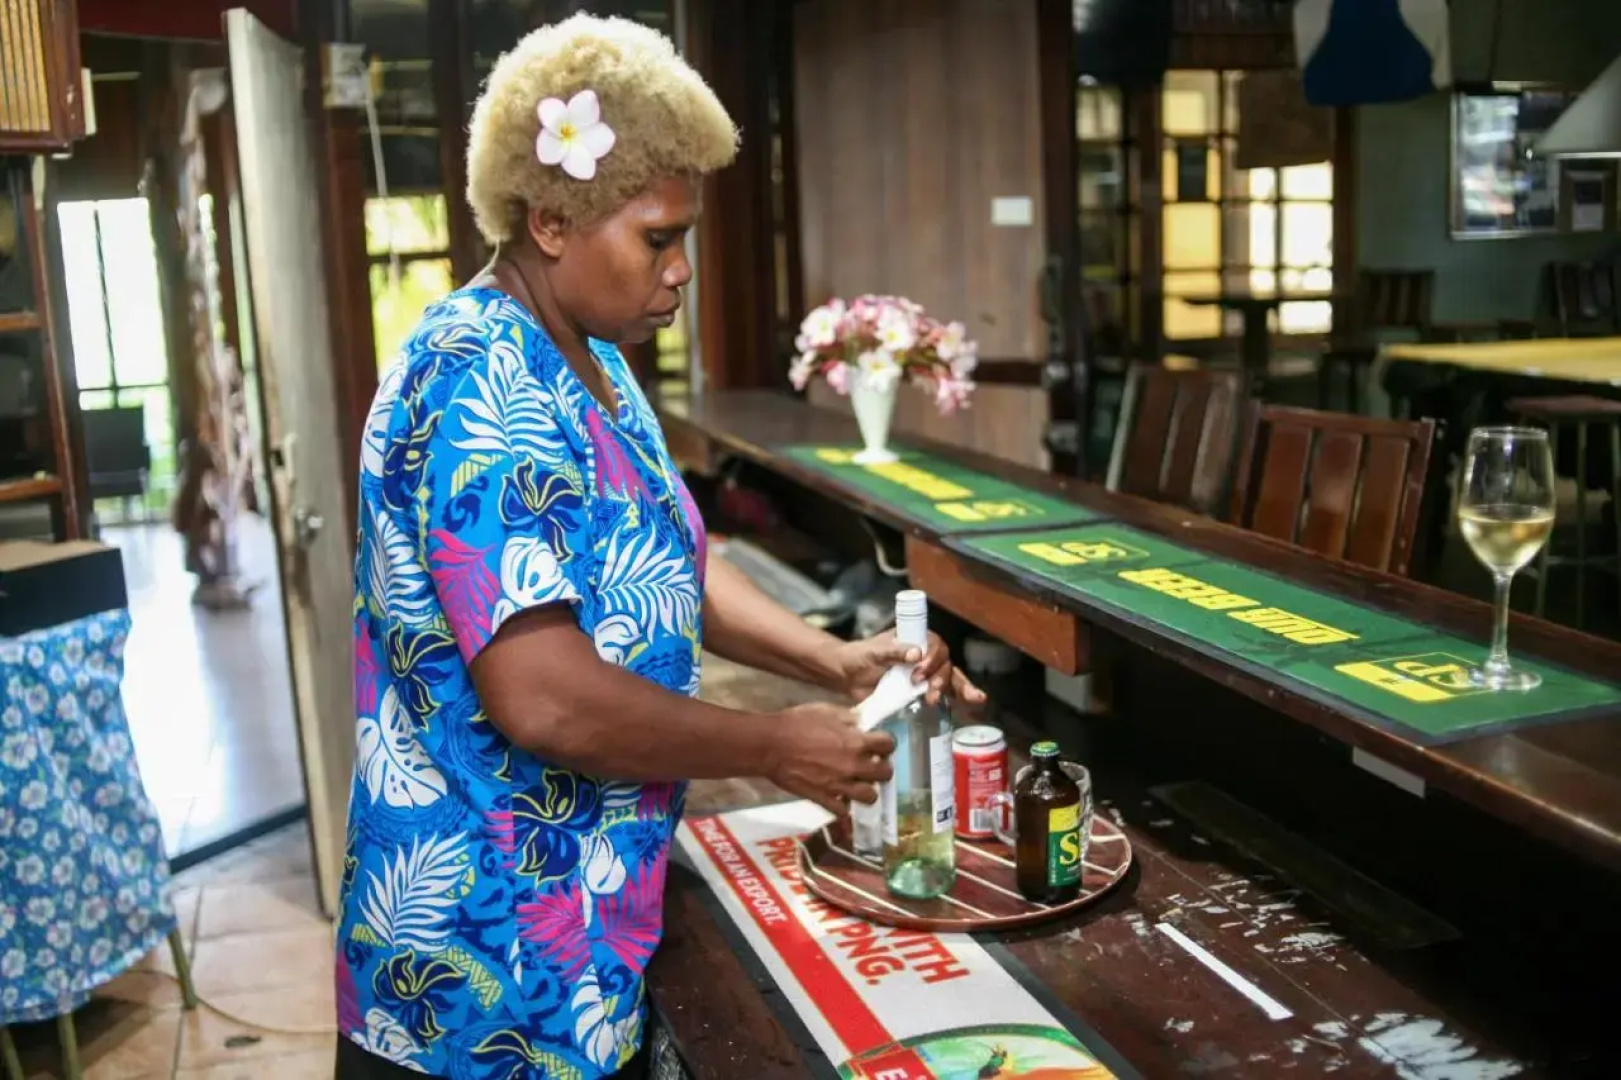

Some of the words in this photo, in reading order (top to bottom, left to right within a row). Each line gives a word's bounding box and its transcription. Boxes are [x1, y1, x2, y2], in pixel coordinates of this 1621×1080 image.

[1117, 567, 1262, 610] BEER
[1226, 607, 1361, 645] OUR
[826, 921, 906, 986] PNG.
